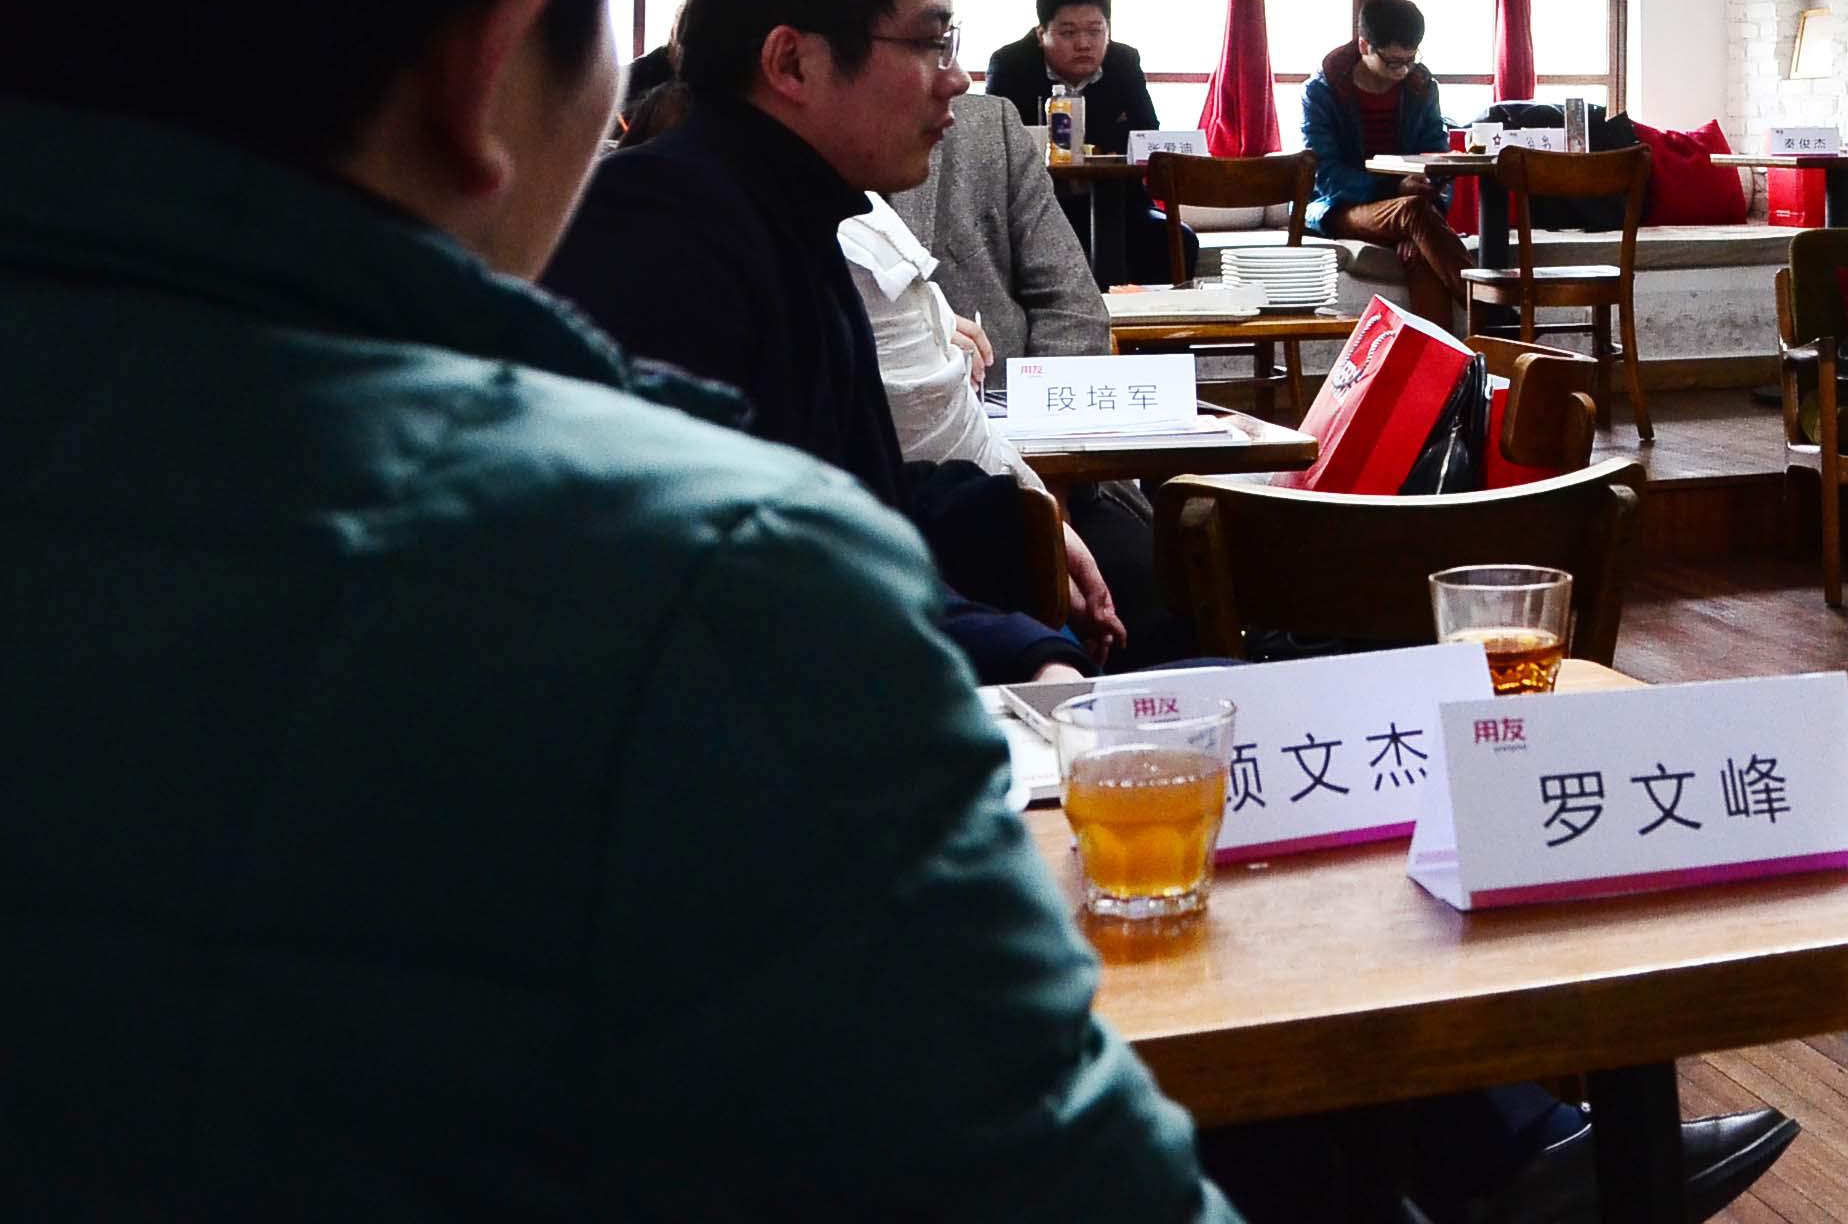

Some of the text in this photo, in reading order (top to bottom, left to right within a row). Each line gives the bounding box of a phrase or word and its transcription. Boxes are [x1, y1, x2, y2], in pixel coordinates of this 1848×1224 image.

[1046, 384, 1159, 412] 段培军
[1473, 717, 1526, 745] 用友
[1538, 752, 1791, 848] 罗文峰
